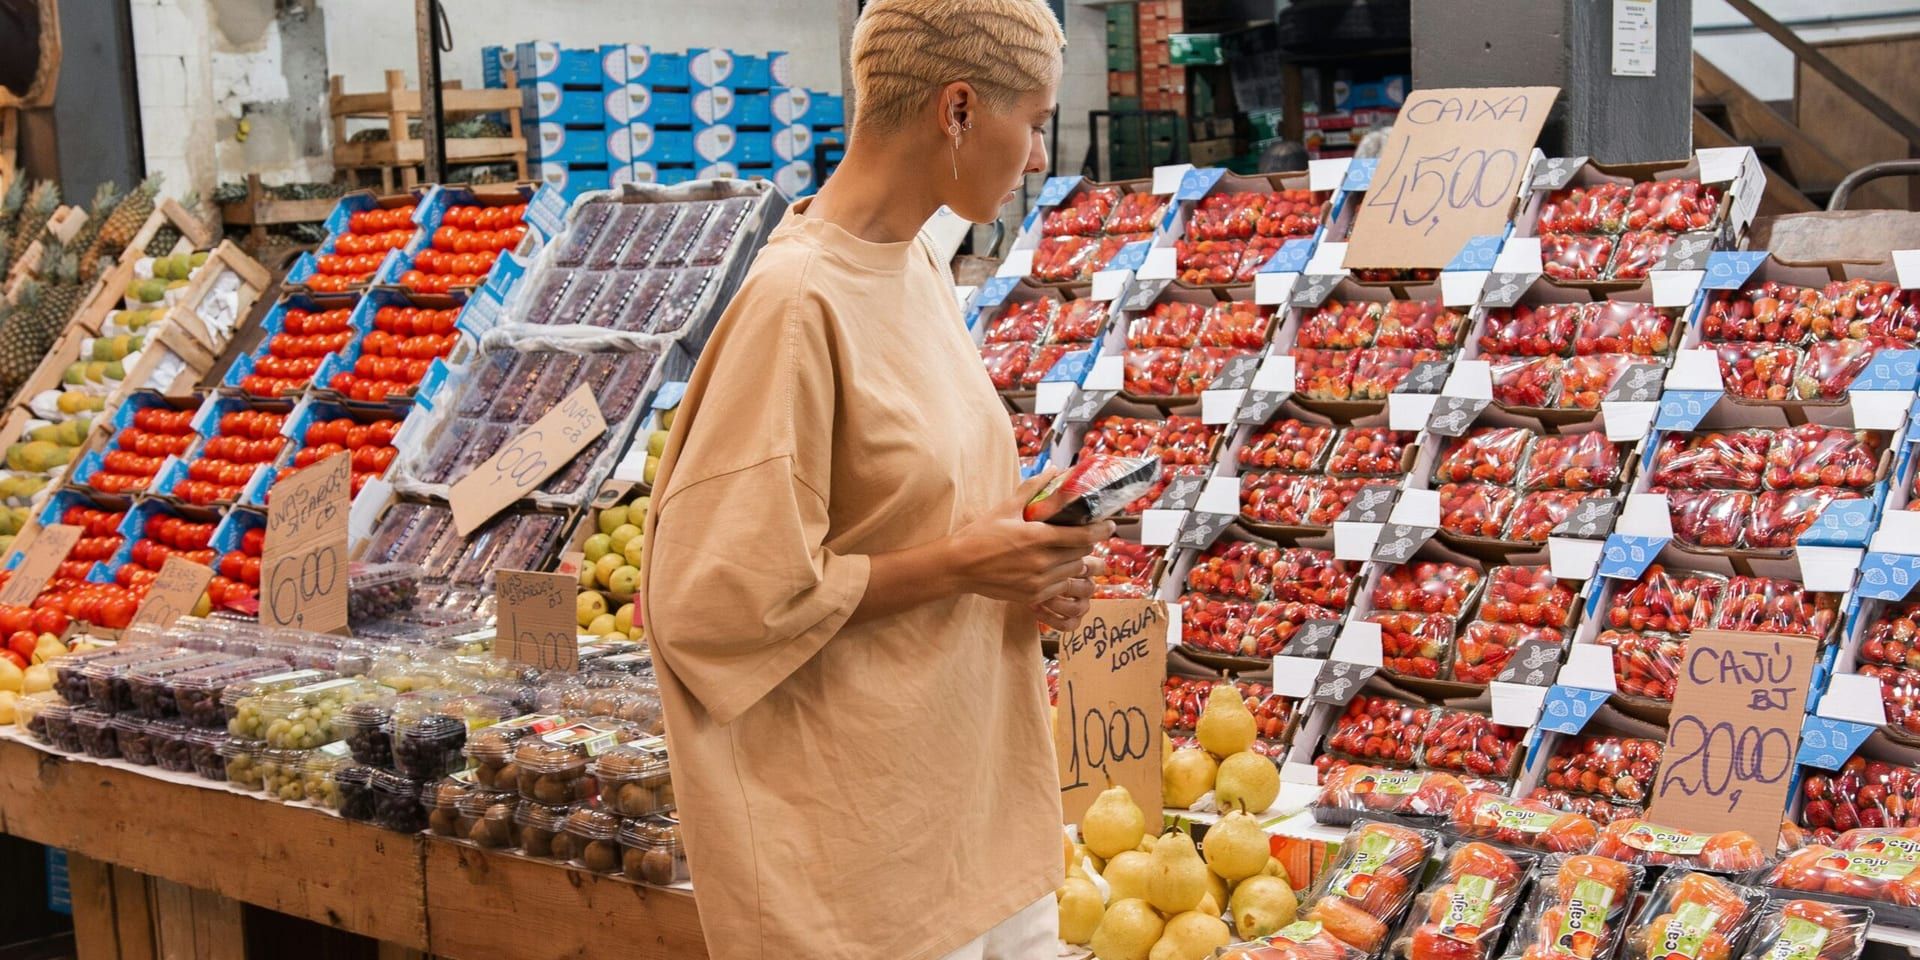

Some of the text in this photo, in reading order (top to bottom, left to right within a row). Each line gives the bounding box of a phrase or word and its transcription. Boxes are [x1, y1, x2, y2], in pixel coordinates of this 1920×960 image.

[1406, 95, 1529, 125] CAIXA
[1367, 135, 1519, 237] 45,00
[270, 482, 309, 531] UVAS
[270, 546, 337, 629] 6,00
[1062, 616, 1107, 661] PERA
[1095, 605, 1157, 659] D'AGUA
[1111, 637, 1150, 673] LOTE
[1688, 642, 1793, 685] CAJÚ
[1746, 687, 1797, 711] BJ
[1659, 714, 1792, 814] 20,00
[1380, 775, 1409, 785] caju
[1504, 810, 1536, 820] caju
[1655, 833, 1690, 844] caju
[1852, 857, 1889, 867] caju
[1451, 892, 1469, 922] caju
[1569, 899, 1587, 929] caju
[1664, 920, 1685, 951] caju
[1774, 938, 1795, 960] aju
